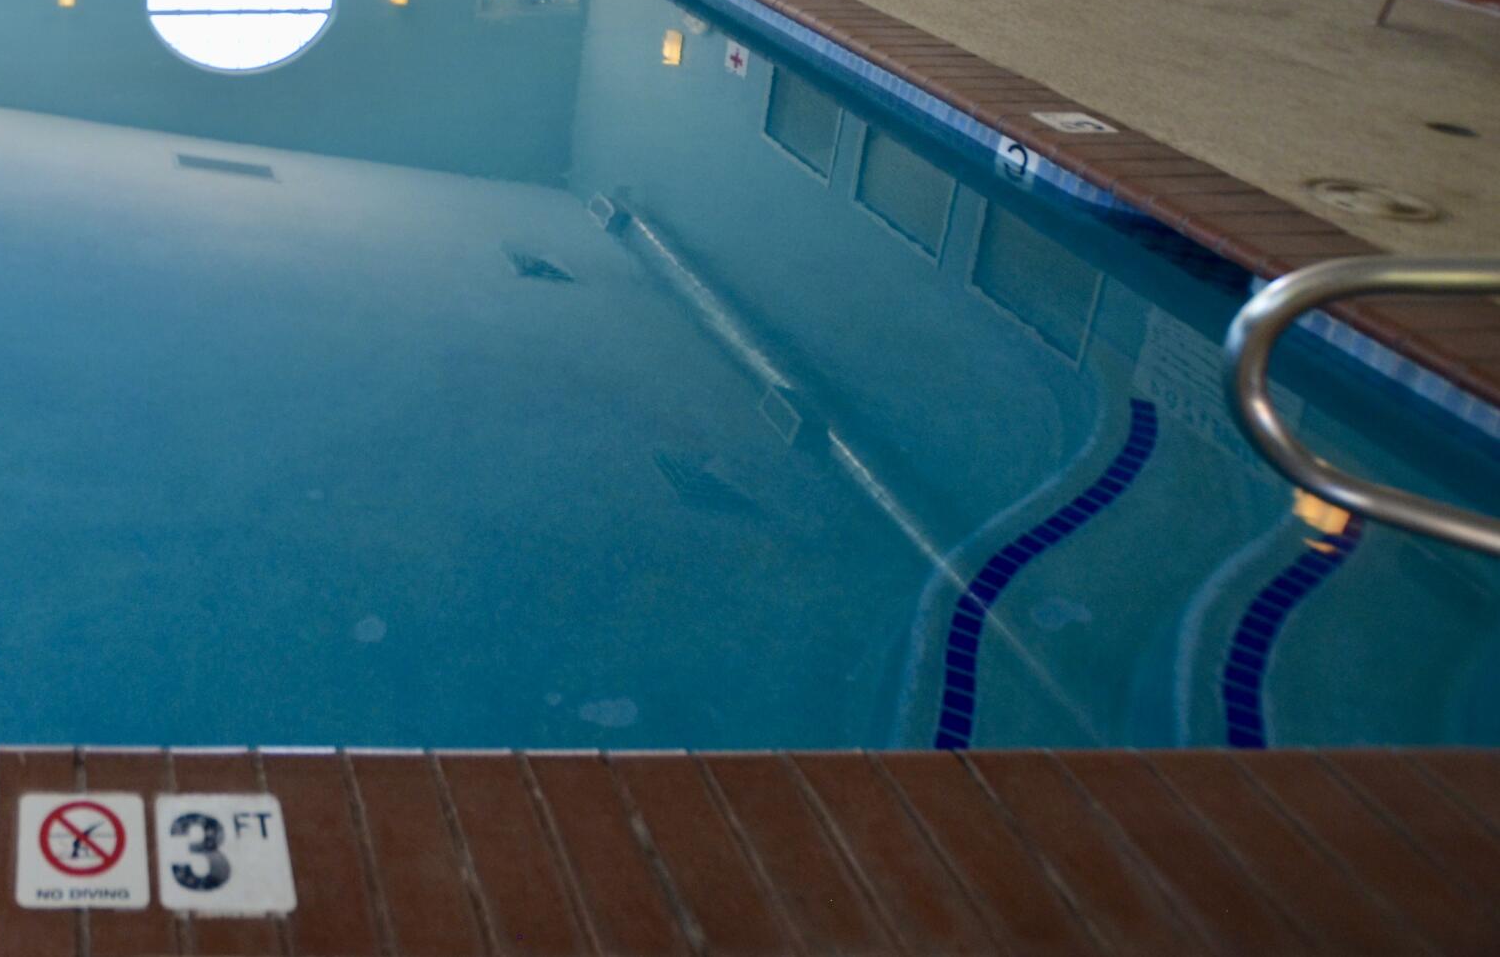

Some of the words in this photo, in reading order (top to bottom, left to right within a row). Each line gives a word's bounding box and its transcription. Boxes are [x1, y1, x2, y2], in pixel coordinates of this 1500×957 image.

[171, 812, 231, 891] 3
[234, 812, 272, 839] FT
[36, 889, 63, 900] NO
[69, 889, 130, 900] DIVING
